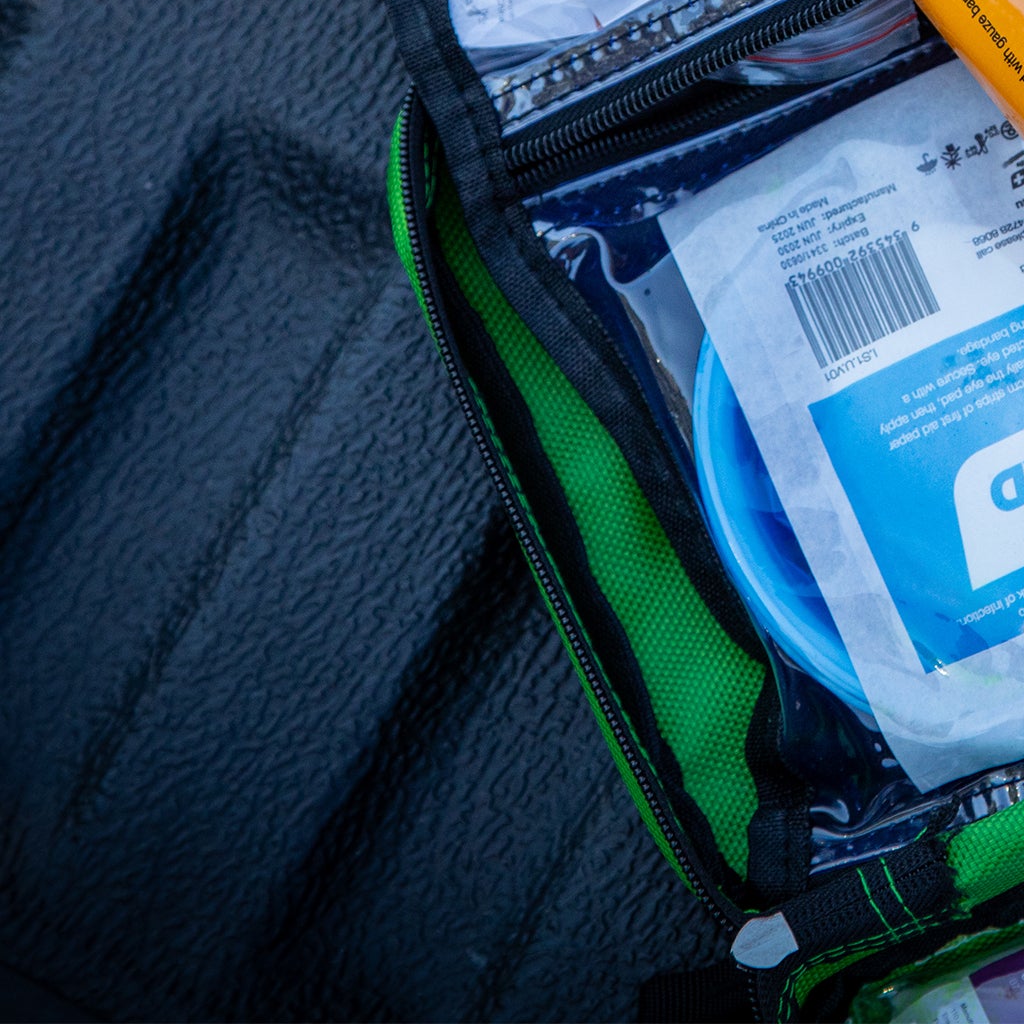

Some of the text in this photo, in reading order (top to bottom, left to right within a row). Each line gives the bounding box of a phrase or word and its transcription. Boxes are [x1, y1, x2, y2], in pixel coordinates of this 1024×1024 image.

[973, 11, 1010, 51] gauze
[756, 195, 829, 235] Made China
[770, 180, 897, 244] Manufactured: JUN 2025
[775, 210, 866, 257] Expiry: JUN 2030
[832, 225, 869, 249] Batch:
[970, 228, 999, 247] 8068
[975, 244, 995, 260] call
[954, 324, 1010, 359] bandage.
[935, 361, 977, 388] Secure
[910, 380, 937, 401] with
[934, 386, 963, 408] pad,
[973, 385, 1008, 412] strips
[876, 410, 911, 436] apply
[908, 400, 937, 421] then
[937, 408, 963, 429] first
[884, 425, 921, 453] paper
[954, 598, 1005, 630] infection.
